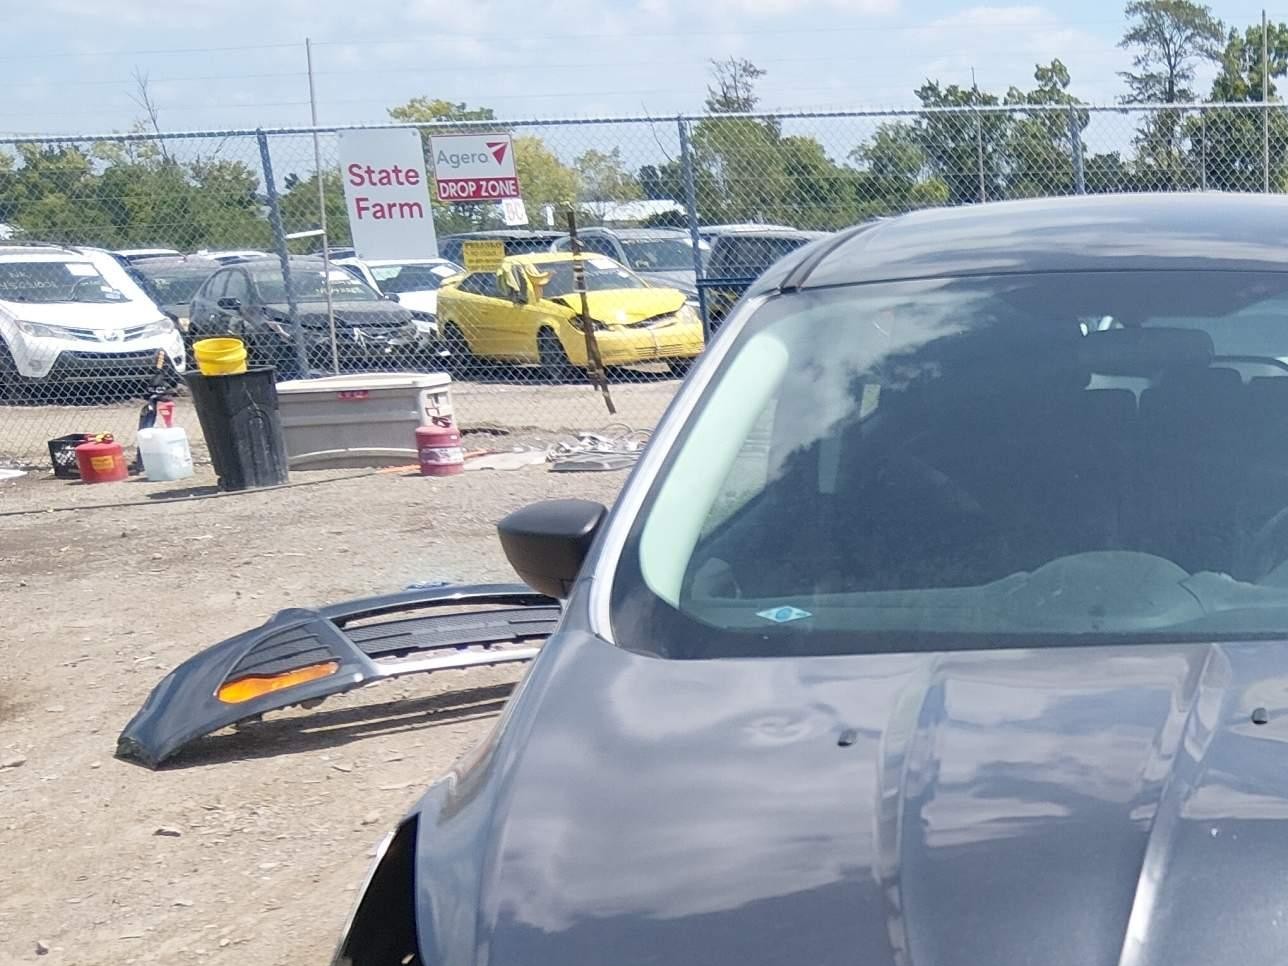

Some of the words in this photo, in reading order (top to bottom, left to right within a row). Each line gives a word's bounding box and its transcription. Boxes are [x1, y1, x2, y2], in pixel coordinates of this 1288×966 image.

[436, 150, 489, 168] Agero
[348, 163, 420, 187] State
[439, 181, 477, 198] DROP
[480, 180, 518, 197] ZONE
[355, 197, 424, 220] Farm
